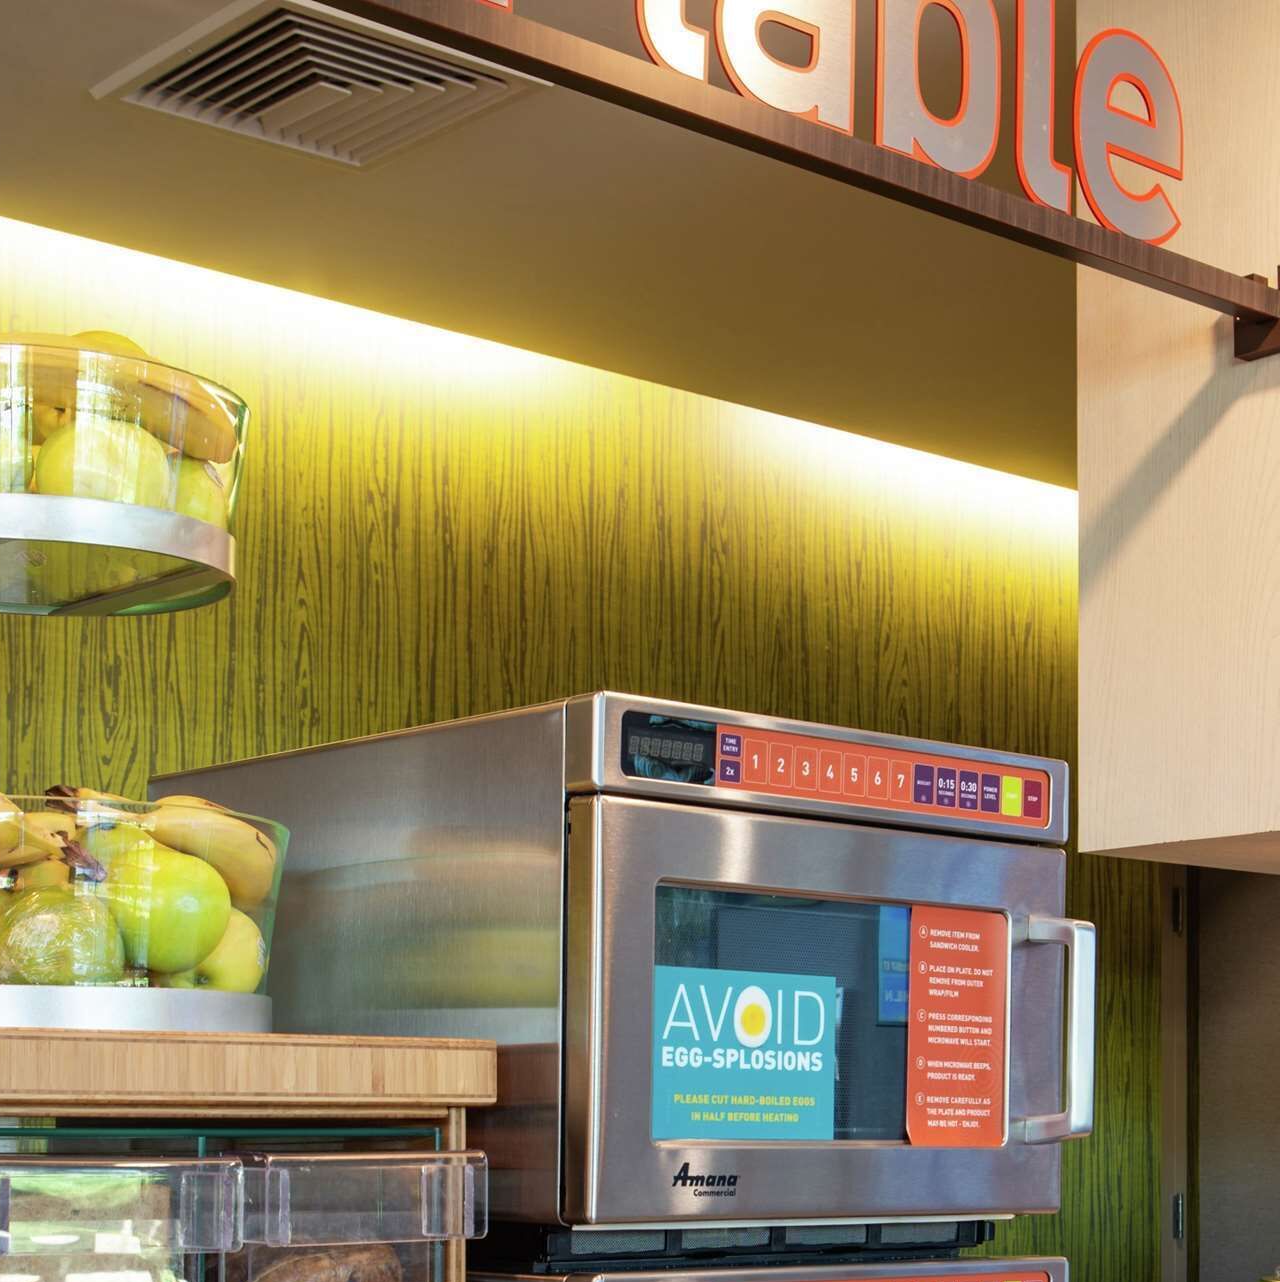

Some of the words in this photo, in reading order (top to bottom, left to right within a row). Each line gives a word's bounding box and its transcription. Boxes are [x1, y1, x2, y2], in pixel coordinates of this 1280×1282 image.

[637, 0, 1183, 246] able
[753, 754, 758, 768] 1
[777, 758, 784, 772] 2
[802, 761, 810, 776] 3
[827, 764, 834, 779] 4
[851, 768, 858, 782] 5
[874, 771, 881, 785] 6
[897, 774, 904, 788] 7
[938, 778, 955, 789] 0:15
[961, 781, 977, 792] 0:30
[930, 929, 951, 938] REMOVE
[966, 932, 980, 940] FROM
[930, 941, 957, 950] SANDWICH
[929, 965, 946, 974] PLACE
[929, 977, 950, 985] REMOVE
[951, 978, 966, 986] FROM
[967, 979, 984, 987] OUTER
[662, 984, 825, 1048] AVOID
[928, 1012, 946, 1020] PRESS
[928, 1025, 958, 1033] NUMBERED
[959, 1026, 980, 1034] BUTTON
[928, 1037, 959, 1045] MICROWAVE
[661, 1046, 823, 1072] EGG-SPLOSIONS
[927, 1072, 951, 1080] PRODUCT
[674, 1093, 710, 1106] PLEASE
[712, 1094, 729, 1105] CUT
[731, 1095, 791, 1107] HARD-BOILED
[792, 1096, 816, 1107] EGGS
[927, 1095, 949, 1104] REMOVE
[951, 1096, 981, 1104] CAREFULLY
[691, 1111, 701, 1121] IN
[703, 1111, 724, 1122] HALF
[727, 1112, 761, 1123] BEFORE
[763, 1112, 799, 1124] HEATING
[672, 1162, 738, 1187] Amana
[693, 1188, 736, 1198] Commercial
